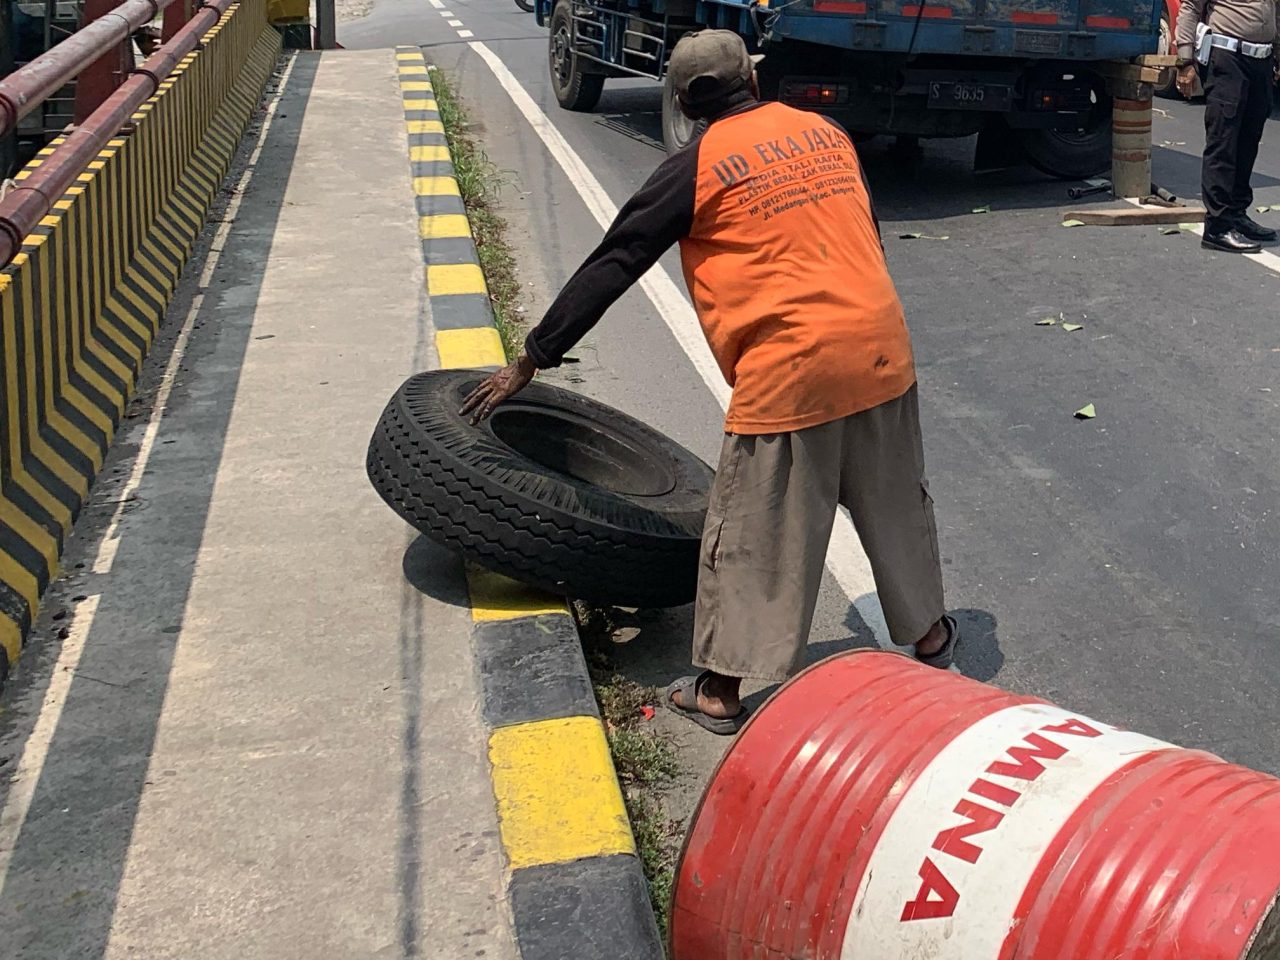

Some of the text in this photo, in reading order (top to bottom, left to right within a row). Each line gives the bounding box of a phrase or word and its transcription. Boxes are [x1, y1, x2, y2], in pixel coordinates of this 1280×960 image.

[931, 83, 941, 99] S
[953, 84, 985, 102] 9635
[711, 126, 848, 187] UD. EKA JAYA
[746, 167, 780, 190] SEDIA
[786, 158, 815, 178] TALI
[815, 152, 845, 169] RAFIA
[738, 182, 773, 205] PLASTIK
[801, 168, 818, 180] ZAK
